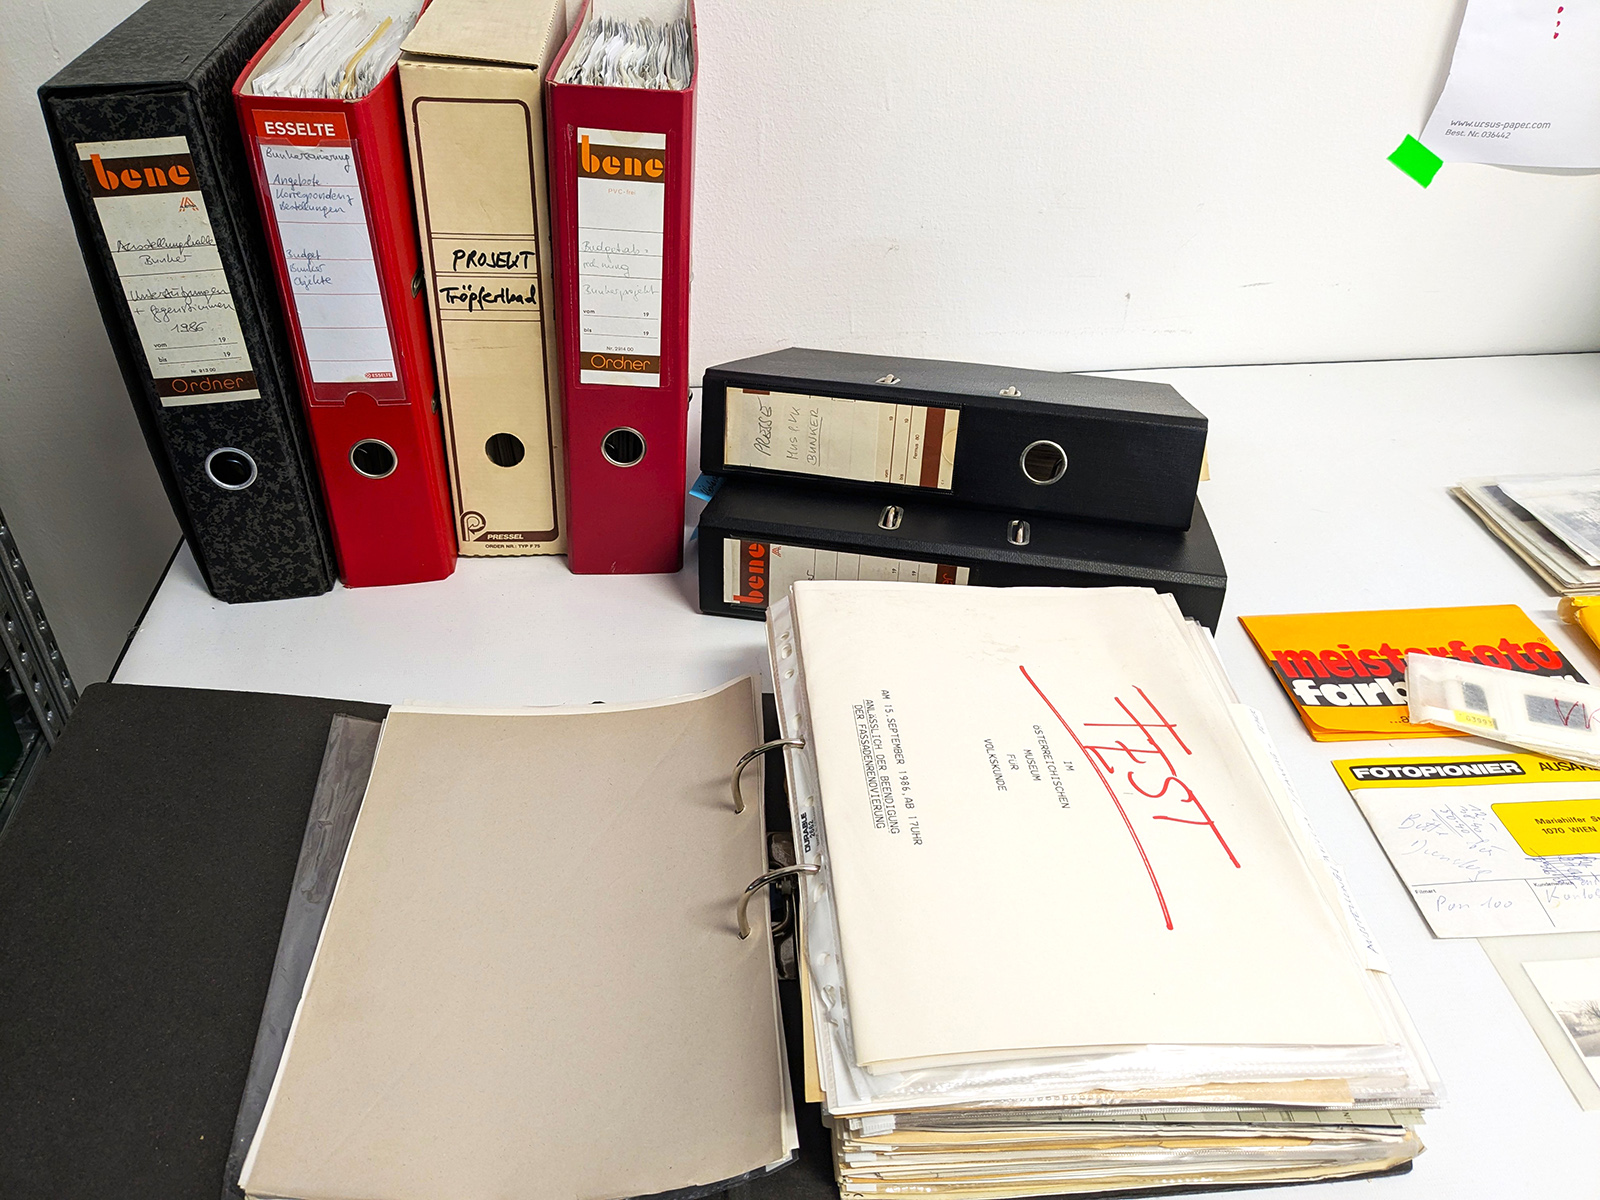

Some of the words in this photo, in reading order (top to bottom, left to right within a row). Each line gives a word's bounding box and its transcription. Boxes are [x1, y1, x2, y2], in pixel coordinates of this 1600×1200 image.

[264, 121, 336, 137] ESSELTE
[1450, 120, 1552, 130] www.ursus-paper.com
[1480, 131, 1512, 139] 036442
[581, 135, 664, 178] bene
[90, 153, 191, 191] bene
[272, 173, 321, 191] Angebote
[138, 253, 192, 266] Bunker
[452, 249, 536, 272] PROJEKT
[170, 321, 208, 333] 1986
[590, 354, 651, 370] Ordner
[171, 376, 245, 394] Ordner
[806, 407, 819, 466] BUNKER
[733, 543, 765, 604] bene
[1271, 638, 1563, 677] meistfoto
[881, 689, 891, 700] AM
[853, 704, 865, 720] DER
[864, 699, 883, 750] ANLÄSSLICH
[875, 754, 888, 771] DER
[984, 738, 1008, 792] VOLKSKUNDE
[1006, 753, 1020, 771] FÜR
[1023, 748, 1042, 782] MUSEUM
[1032, 724, 1071, 809] ÖSTERREICHISCHEN
[1063, 761, 1076, 772] IM
[1352, 763, 1522, 779] FOTOPIONIER
[858, 723, 886, 830] FASSADENRENOVIERUNG
[1083, 685, 1242, 869] FEST
[879, 775, 901, 835] BEENDIGUNG
[1534, 816, 1587, 825] Mariahilfer
[800, 811, 811, 854] DURABLE
[1541, 827, 1566, 835] 1070
[1568, 826, 1598, 834] WIEN
